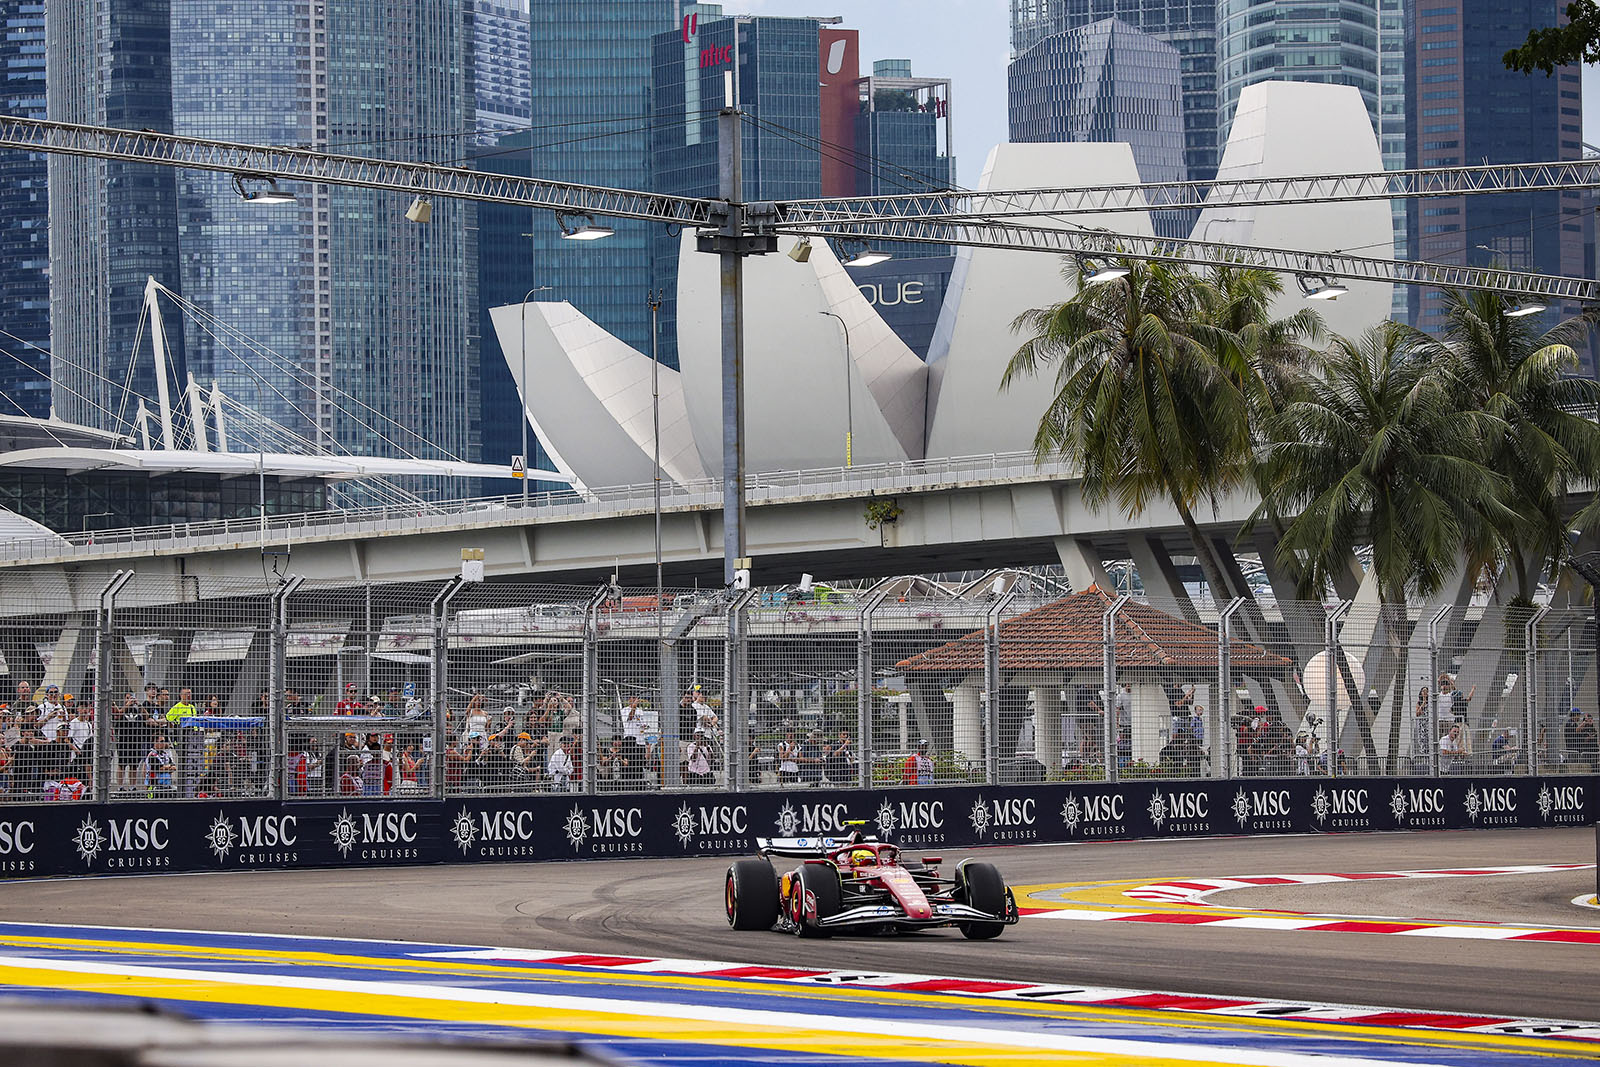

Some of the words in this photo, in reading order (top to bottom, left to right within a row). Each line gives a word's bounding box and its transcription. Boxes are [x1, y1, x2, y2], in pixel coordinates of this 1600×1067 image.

[700, 43, 732, 68] ntuc
[1083, 795, 1124, 822] MSC
[1169, 792, 1208, 818] MSC
[1253, 790, 1290, 816] MSC
[1332, 789, 1368, 814] MSC
[1409, 788, 1445, 813] MSC
[1482, 787, 1517, 812] MSC
[1554, 786, 1583, 810] MSC
[592, 808, 641, 837] MSC
[700, 806, 747, 834] MSC
[802, 804, 848, 832] MSC
[900, 801, 943, 829] MSC
[993, 799, 1035, 826] MSC
[1332, 819, 1369, 827] CRUISES
[1410, 817, 1445, 825] CRUISES
[1483, 816, 1518, 824] CRUISES
[1554, 814, 1584, 822] CRUISES
[108, 818, 169, 850] MSC
[240, 815, 297, 847] MSC
[362, 812, 417, 843] MSC
[481, 811, 533, 840] MSC
[993, 830, 1036, 840] CRUISES
[1083, 826, 1125, 836] CRUISES
[1169, 823, 1210, 832] CRUISES
[1253, 821, 1291, 829] CRUISES
[0, 821, 34, 854] SC
[592, 843, 642, 853] CRUISES
[700, 840, 748, 849] CRUISES
[900, 834, 944, 843] CRUISES
[108, 857, 169, 867] CRUISES
[240, 853, 297, 863] CRUISES
[362, 849, 417, 859] CRUISES
[481, 847, 533, 856] CRUISES
[3, 861, 35, 871] ISES
